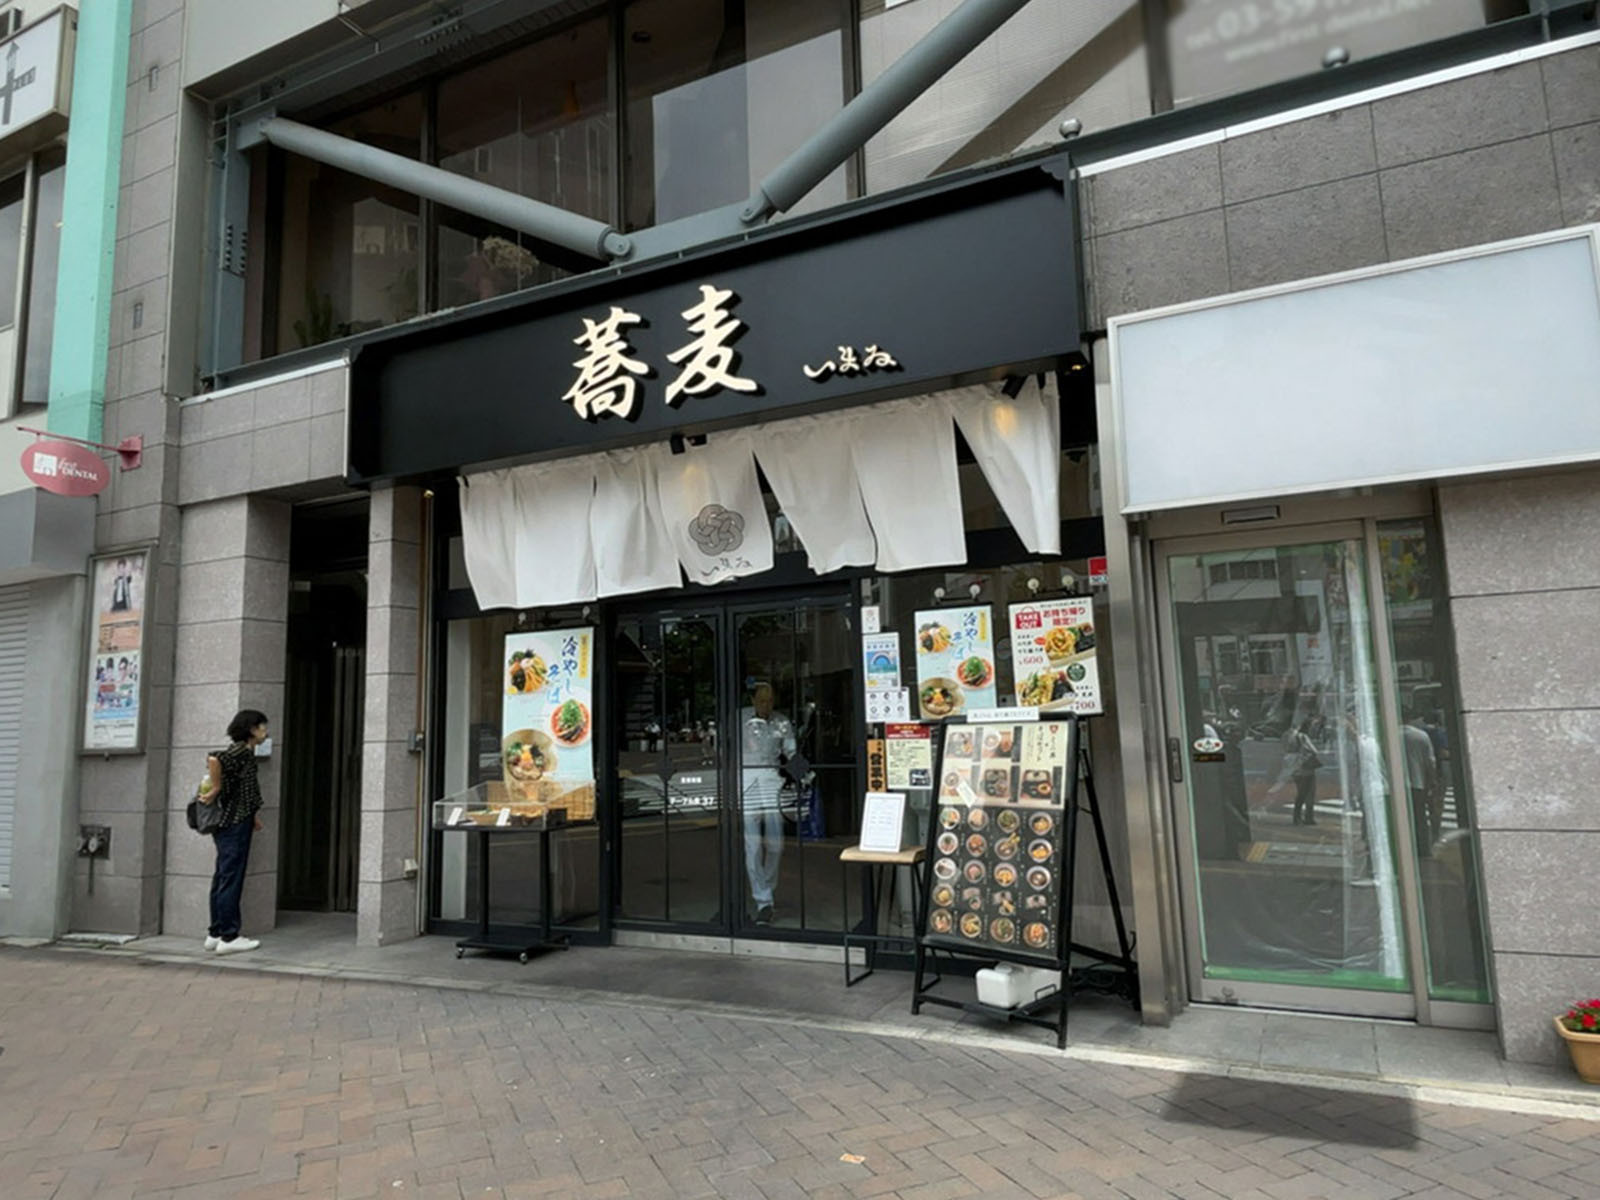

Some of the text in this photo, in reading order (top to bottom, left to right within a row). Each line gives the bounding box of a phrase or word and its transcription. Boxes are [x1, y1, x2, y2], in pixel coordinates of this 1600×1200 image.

[561, 285, 758, 420] 蕎麦
[62, 465, 99, 481] DENTAL
[963, 611, 978, 652] 冷やし
[1018, 612, 1039, 621] TAKE
[546, 663, 561, 704] そば
[561, 635, 579, 694] 冷やし
[870, 752, 883, 791] 営業中
[703, 796, 715, 806] 37
